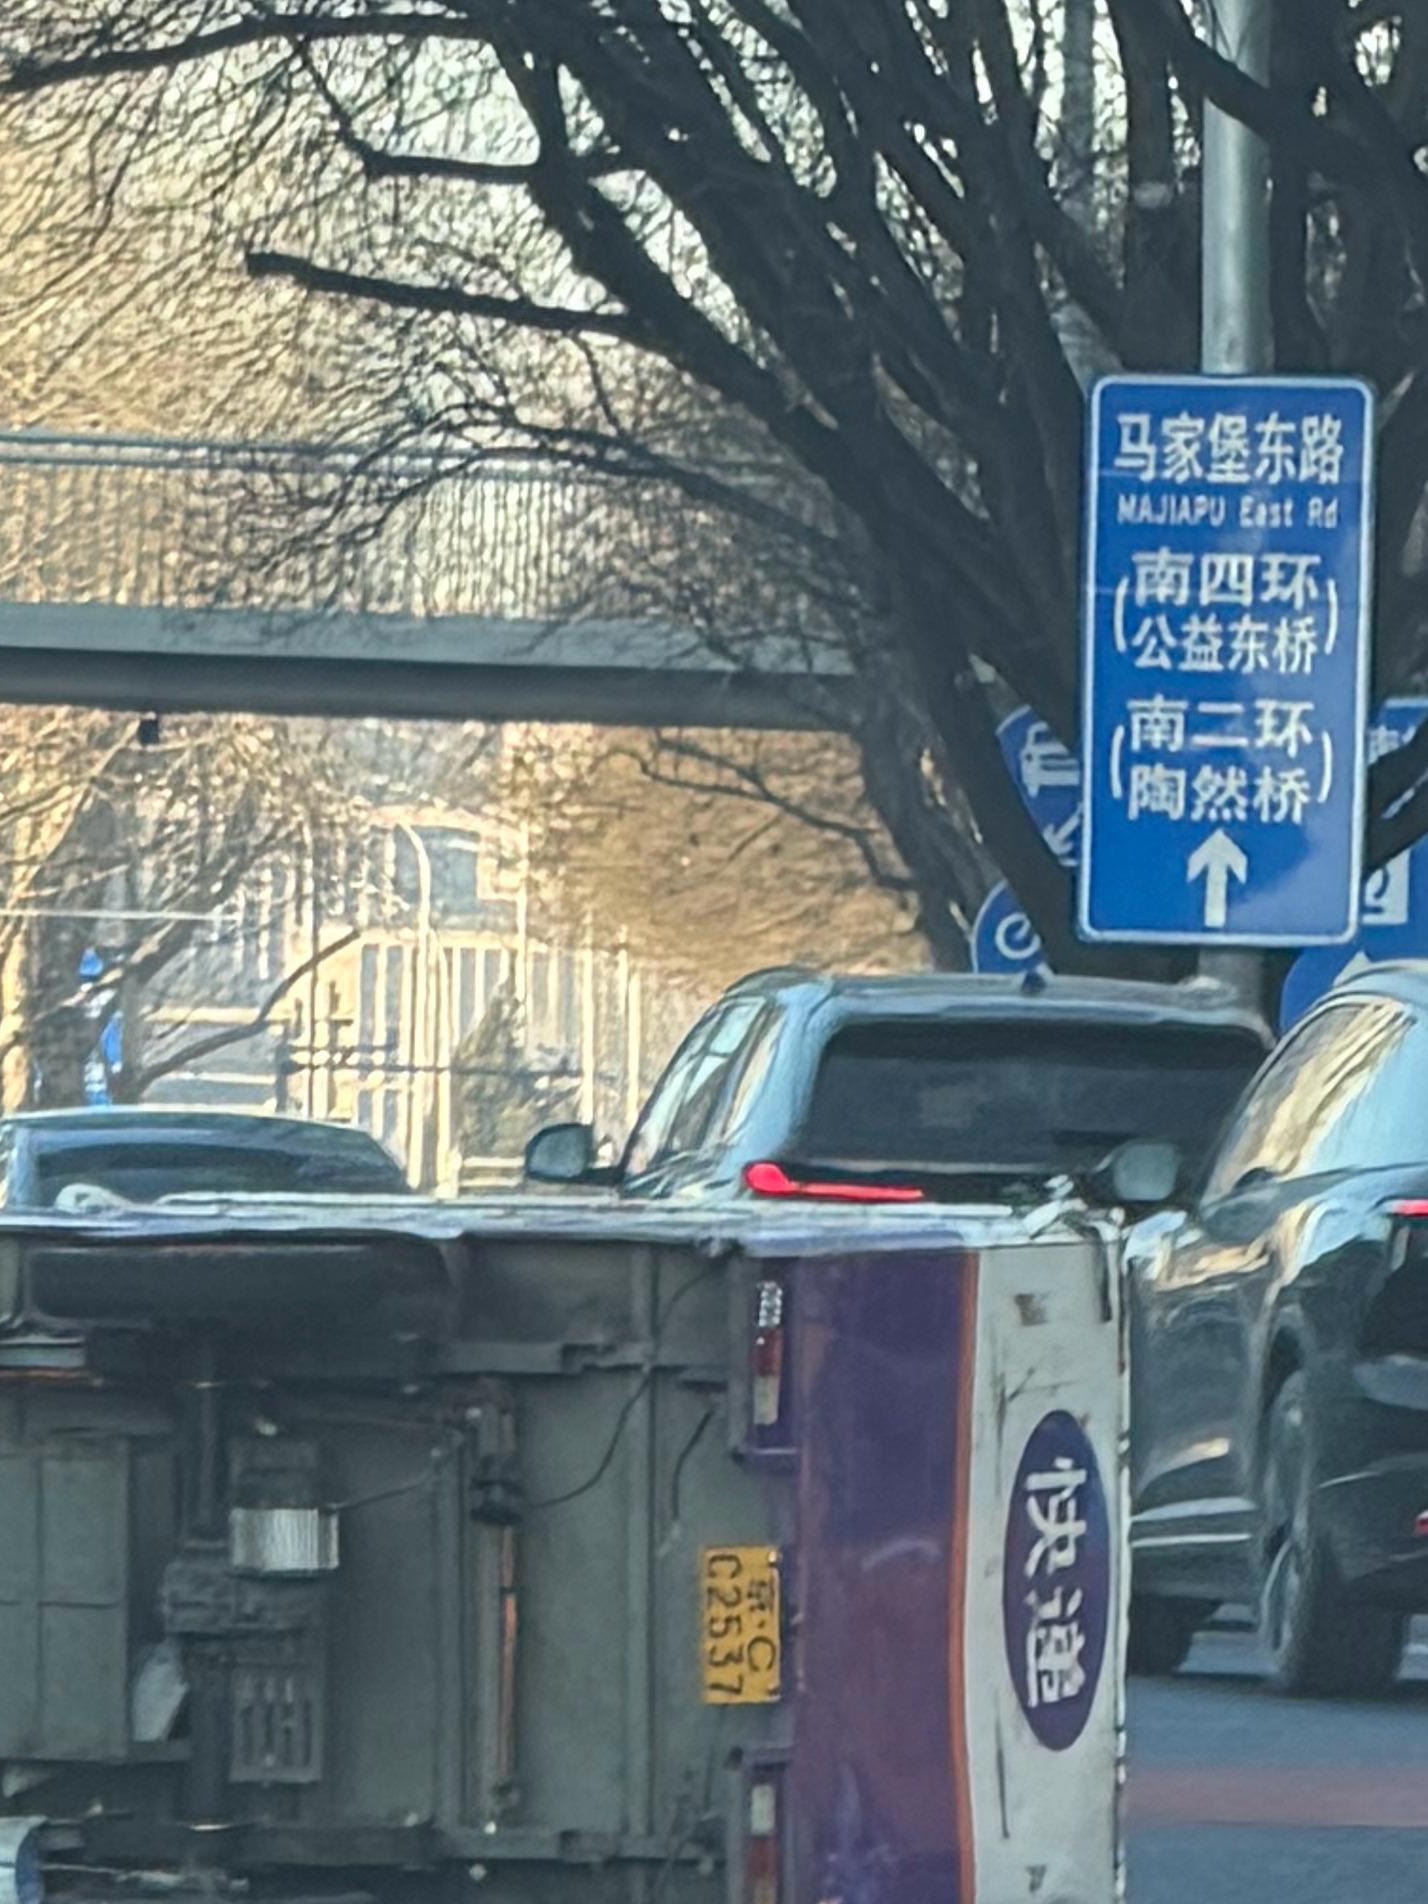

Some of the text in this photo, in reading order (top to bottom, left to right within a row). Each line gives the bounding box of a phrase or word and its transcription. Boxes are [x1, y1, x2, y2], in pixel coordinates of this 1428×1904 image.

[1113, 410, 1345, 486] 马家堡东路
[1116, 492, 1339, 529] MAJIAPU East Rd
[705, 1552, 745, 1698] C2537
